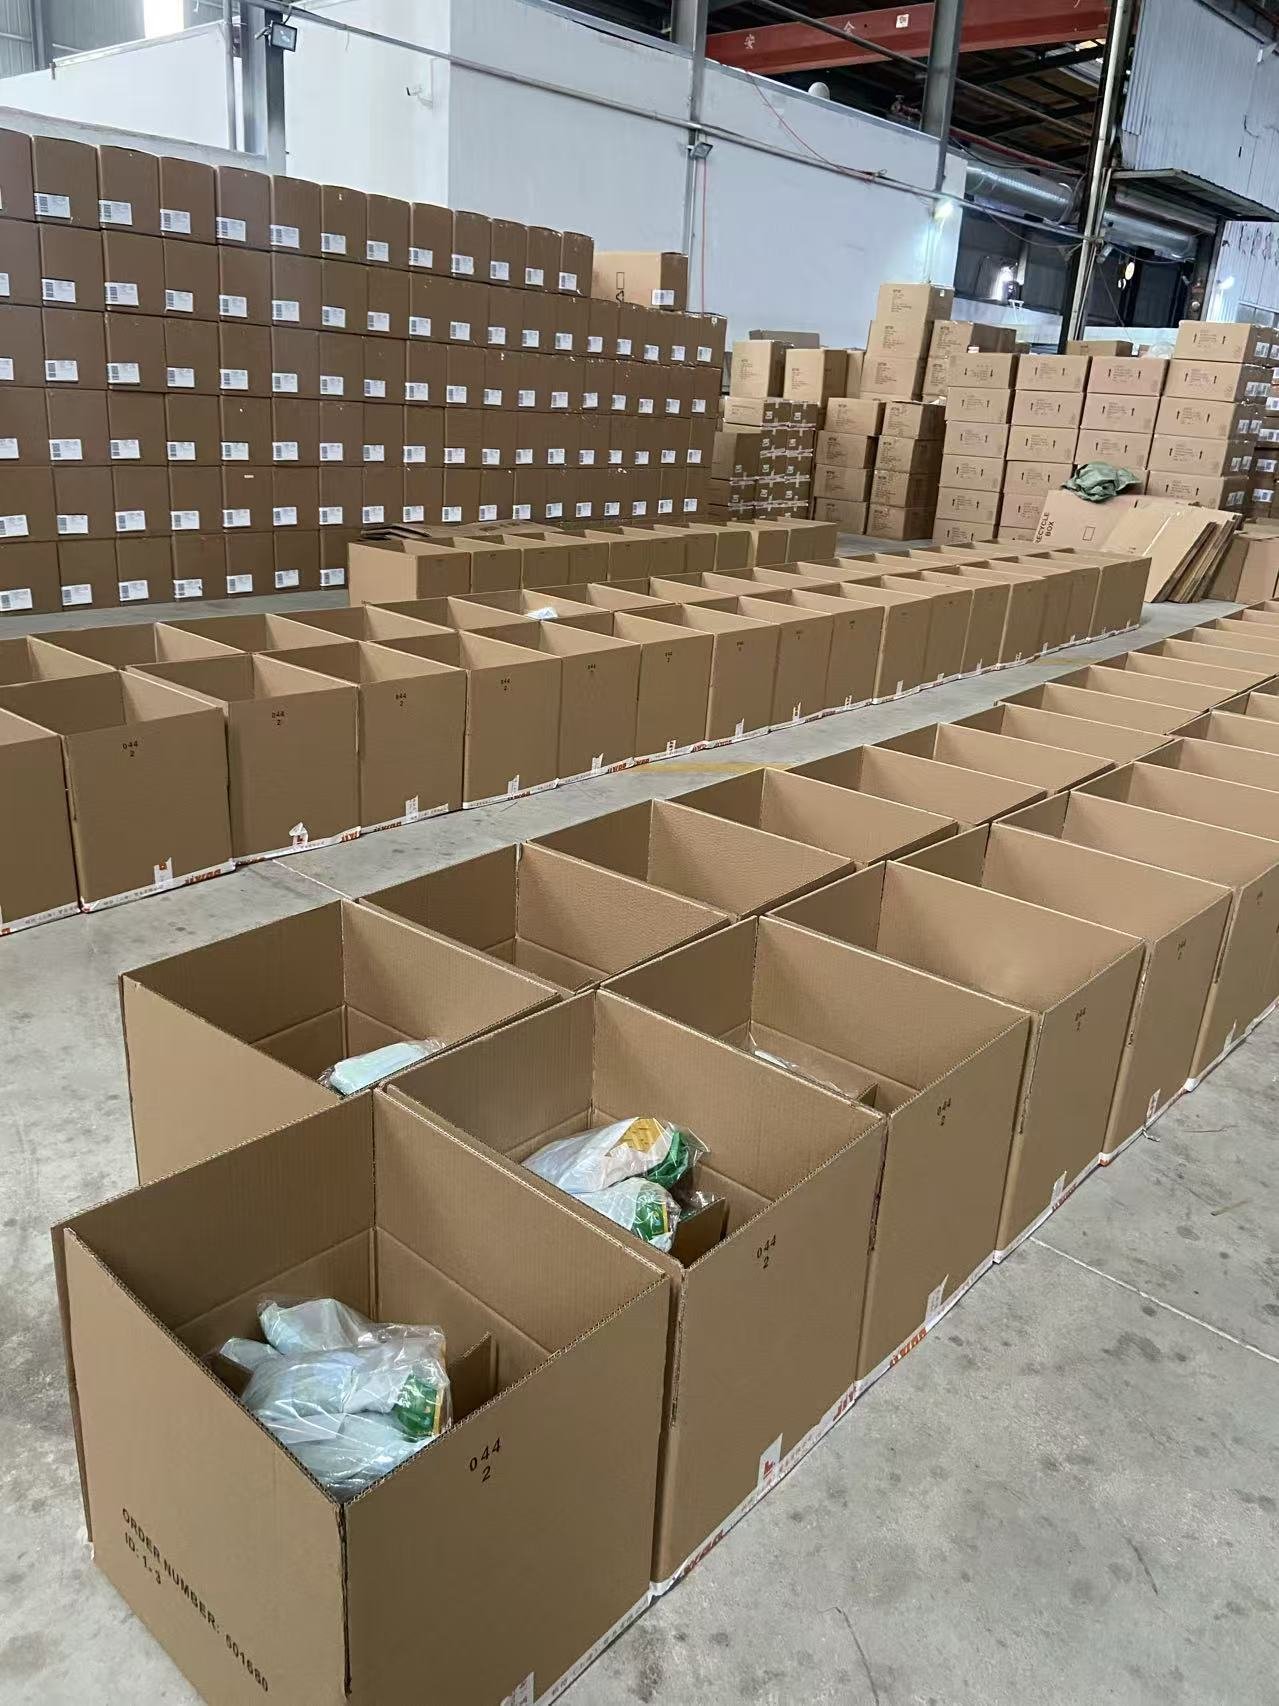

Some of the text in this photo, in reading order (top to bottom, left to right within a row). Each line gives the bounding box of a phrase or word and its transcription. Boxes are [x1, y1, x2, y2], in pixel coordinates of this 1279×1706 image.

[1045, 520, 1055, 537] BOX
[756, 1234, 777, 1259] 044
[469, 1437, 501, 1473] 044
[482, 1465, 491, 1483] 2
[122, 1508, 161, 1564] ORDER
[163, 1559, 221, 1635] NUMBER:
